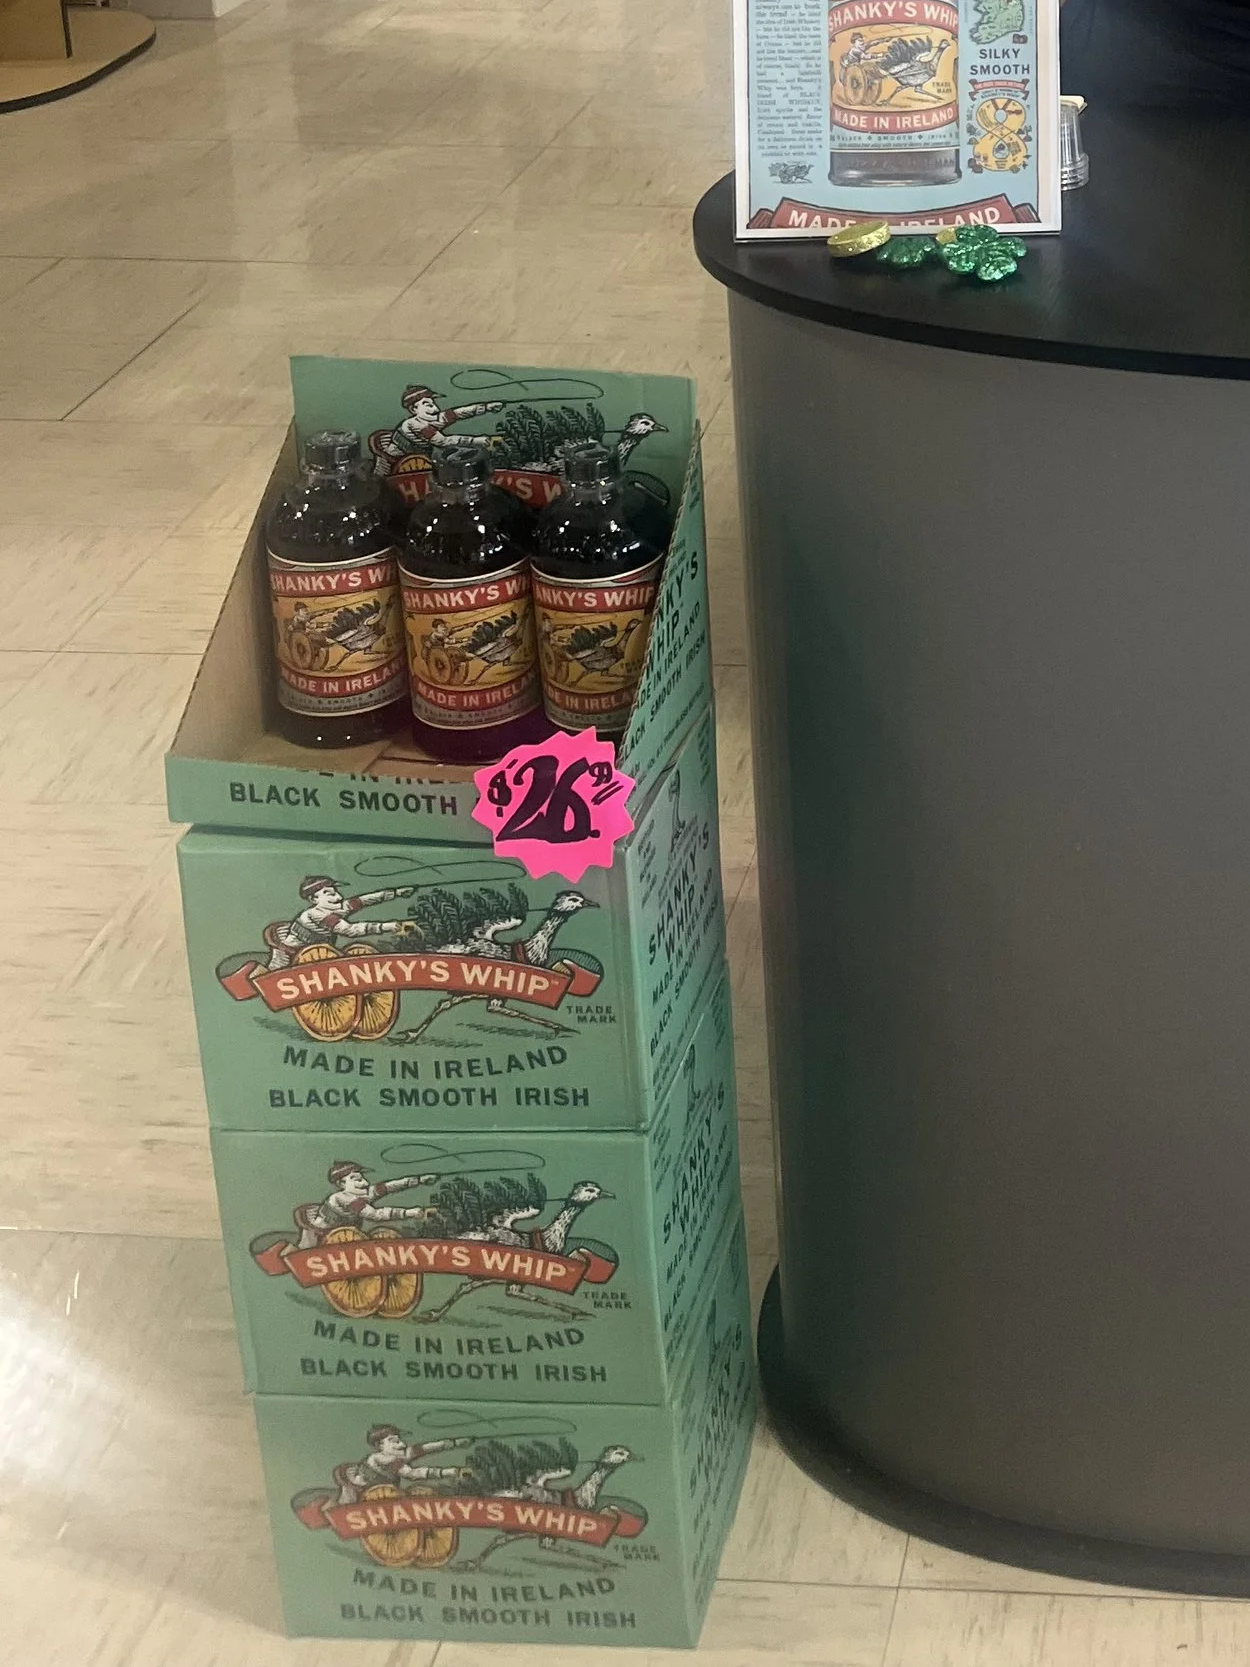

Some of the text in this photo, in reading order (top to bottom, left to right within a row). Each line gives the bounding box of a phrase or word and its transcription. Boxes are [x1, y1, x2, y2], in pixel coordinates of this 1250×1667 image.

[828, 0, 917, 32] SHANKY'S
[978, 48, 1021, 60] SILKY
[969, 64, 1031, 76] SMOOTH
[834, 107, 954, 130] MADE IN IRELAND
[403, 584, 500, 612] SHANKY'S
[663, 600, 701, 667] IRELAND
[281, 665, 340, 694] MADE IN
[417, 682, 479, 708] MADE IN
[565, 696, 580, 709] IN
[650, 670, 683, 723] SMOOTH
[229, 781, 458, 816] BLACK SMOOTH
[648, 820, 710, 967] SHANKY'S
[664, 883, 697, 965] WHIP
[276, 960, 550, 1000] SHANKY'S WHIP
[652, 966, 675, 1009] MADE
[566, 1004, 613, 1016] TRADE
[576, 1015, 618, 1024] MARK
[649, 1008, 674, 1058] BLACK
[282, 1044, 569, 1080] MADE IN IRELAND
[268, 1086, 590, 1109] BLACK SMOOTH IRISH
[662, 1080, 725, 1246] SHANKY'S
[305, 1244, 569, 1282] SHANKY'S WHIP
[582, 1291, 629, 1300] TRADE
[592, 1299, 633, 1310] MARK
[312, 1319, 586, 1355] MADE IN IRELAND
[299, 1357, 608, 1383] BLACK SMOOTH IRISH
[345, 1502, 599, 1537] SHANKY'S WHIP
[622, 1551, 661, 1562] MARK
[351, 1567, 616, 1603] MADE IN IRELAND
[340, 1602, 637, 1630] BLACK SMOOTH IRISH
